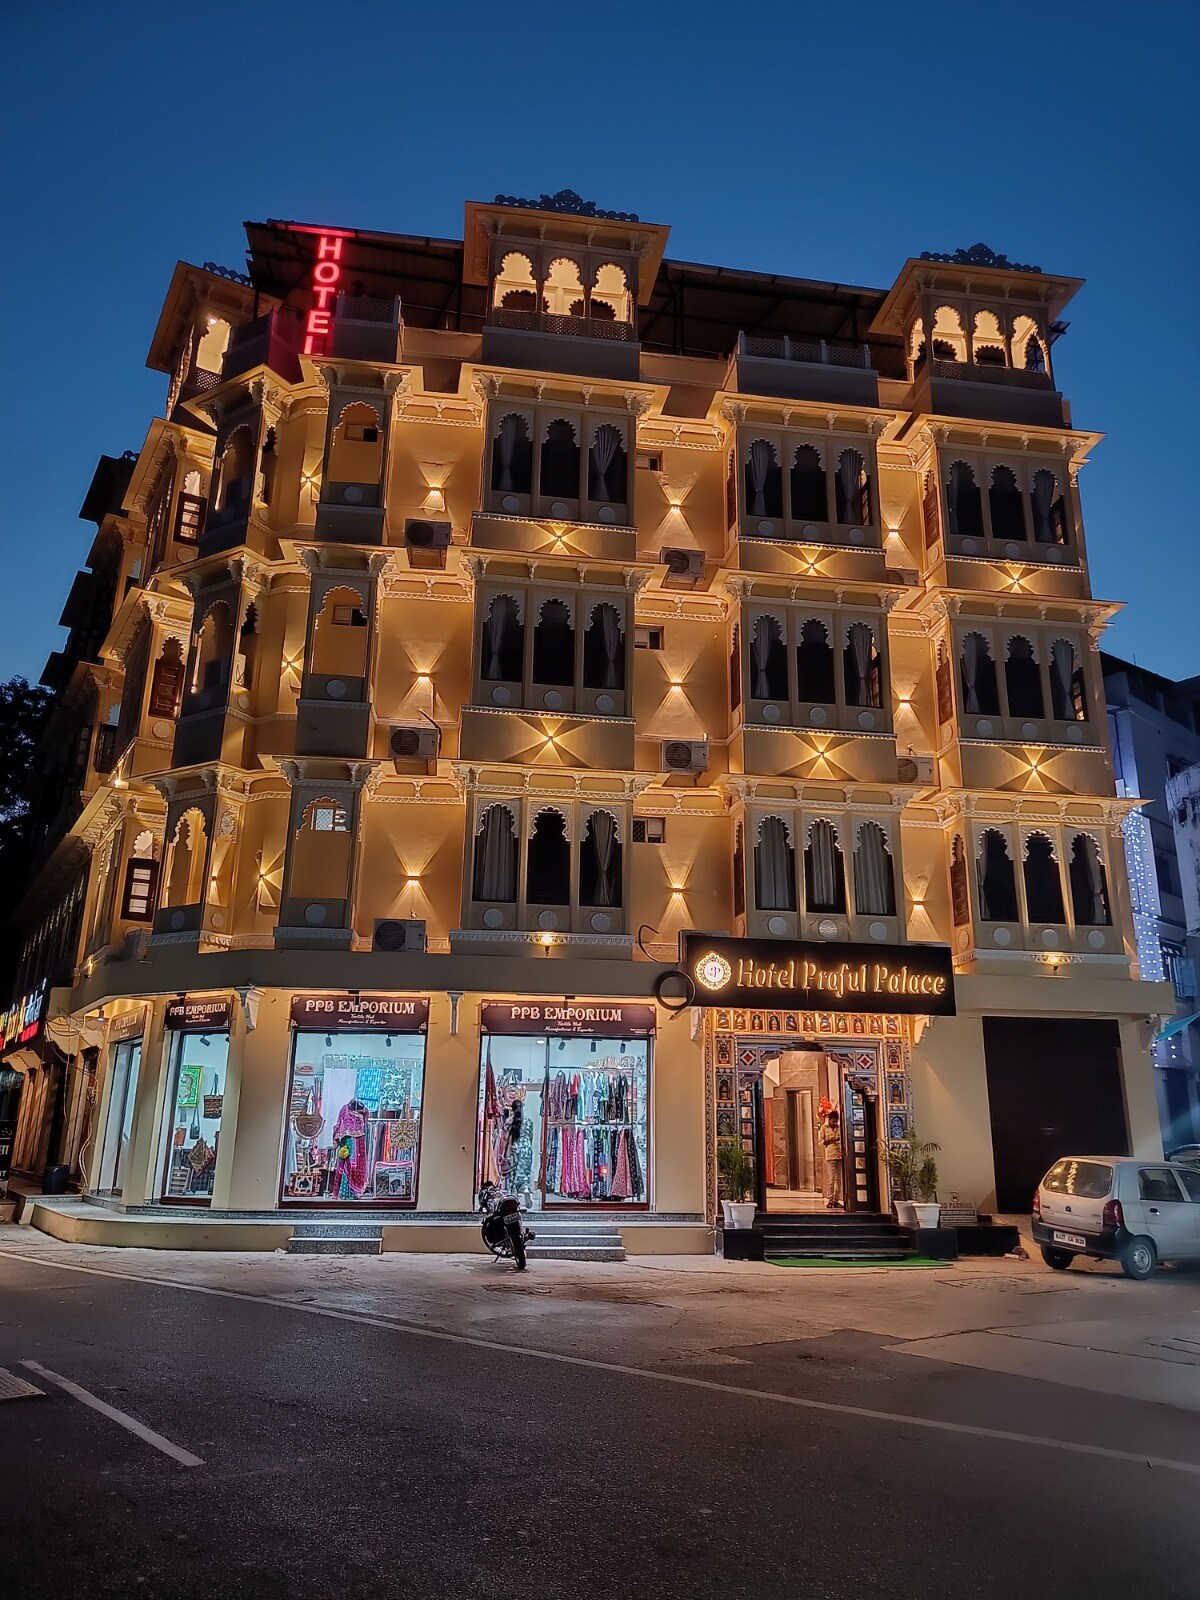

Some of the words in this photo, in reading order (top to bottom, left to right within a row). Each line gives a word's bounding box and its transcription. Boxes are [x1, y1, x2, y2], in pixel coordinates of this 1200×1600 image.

[304, 237, 342, 355] HOTEL
[737, 958, 795, 990] Hotel
[802, 960, 867, 998] Praful
[873, 964, 946, 995] Palace
[170, 1006, 185, 1016] PPB
[185, 1003, 227, 1015] EMPORIUM
[305, 1000, 334, 1012] PPB
[338, 1001, 416, 1015] EMPORIUM
[511, 1006, 541, 1020] PPB
[544, 1008, 622, 1022] EMPORIUM
